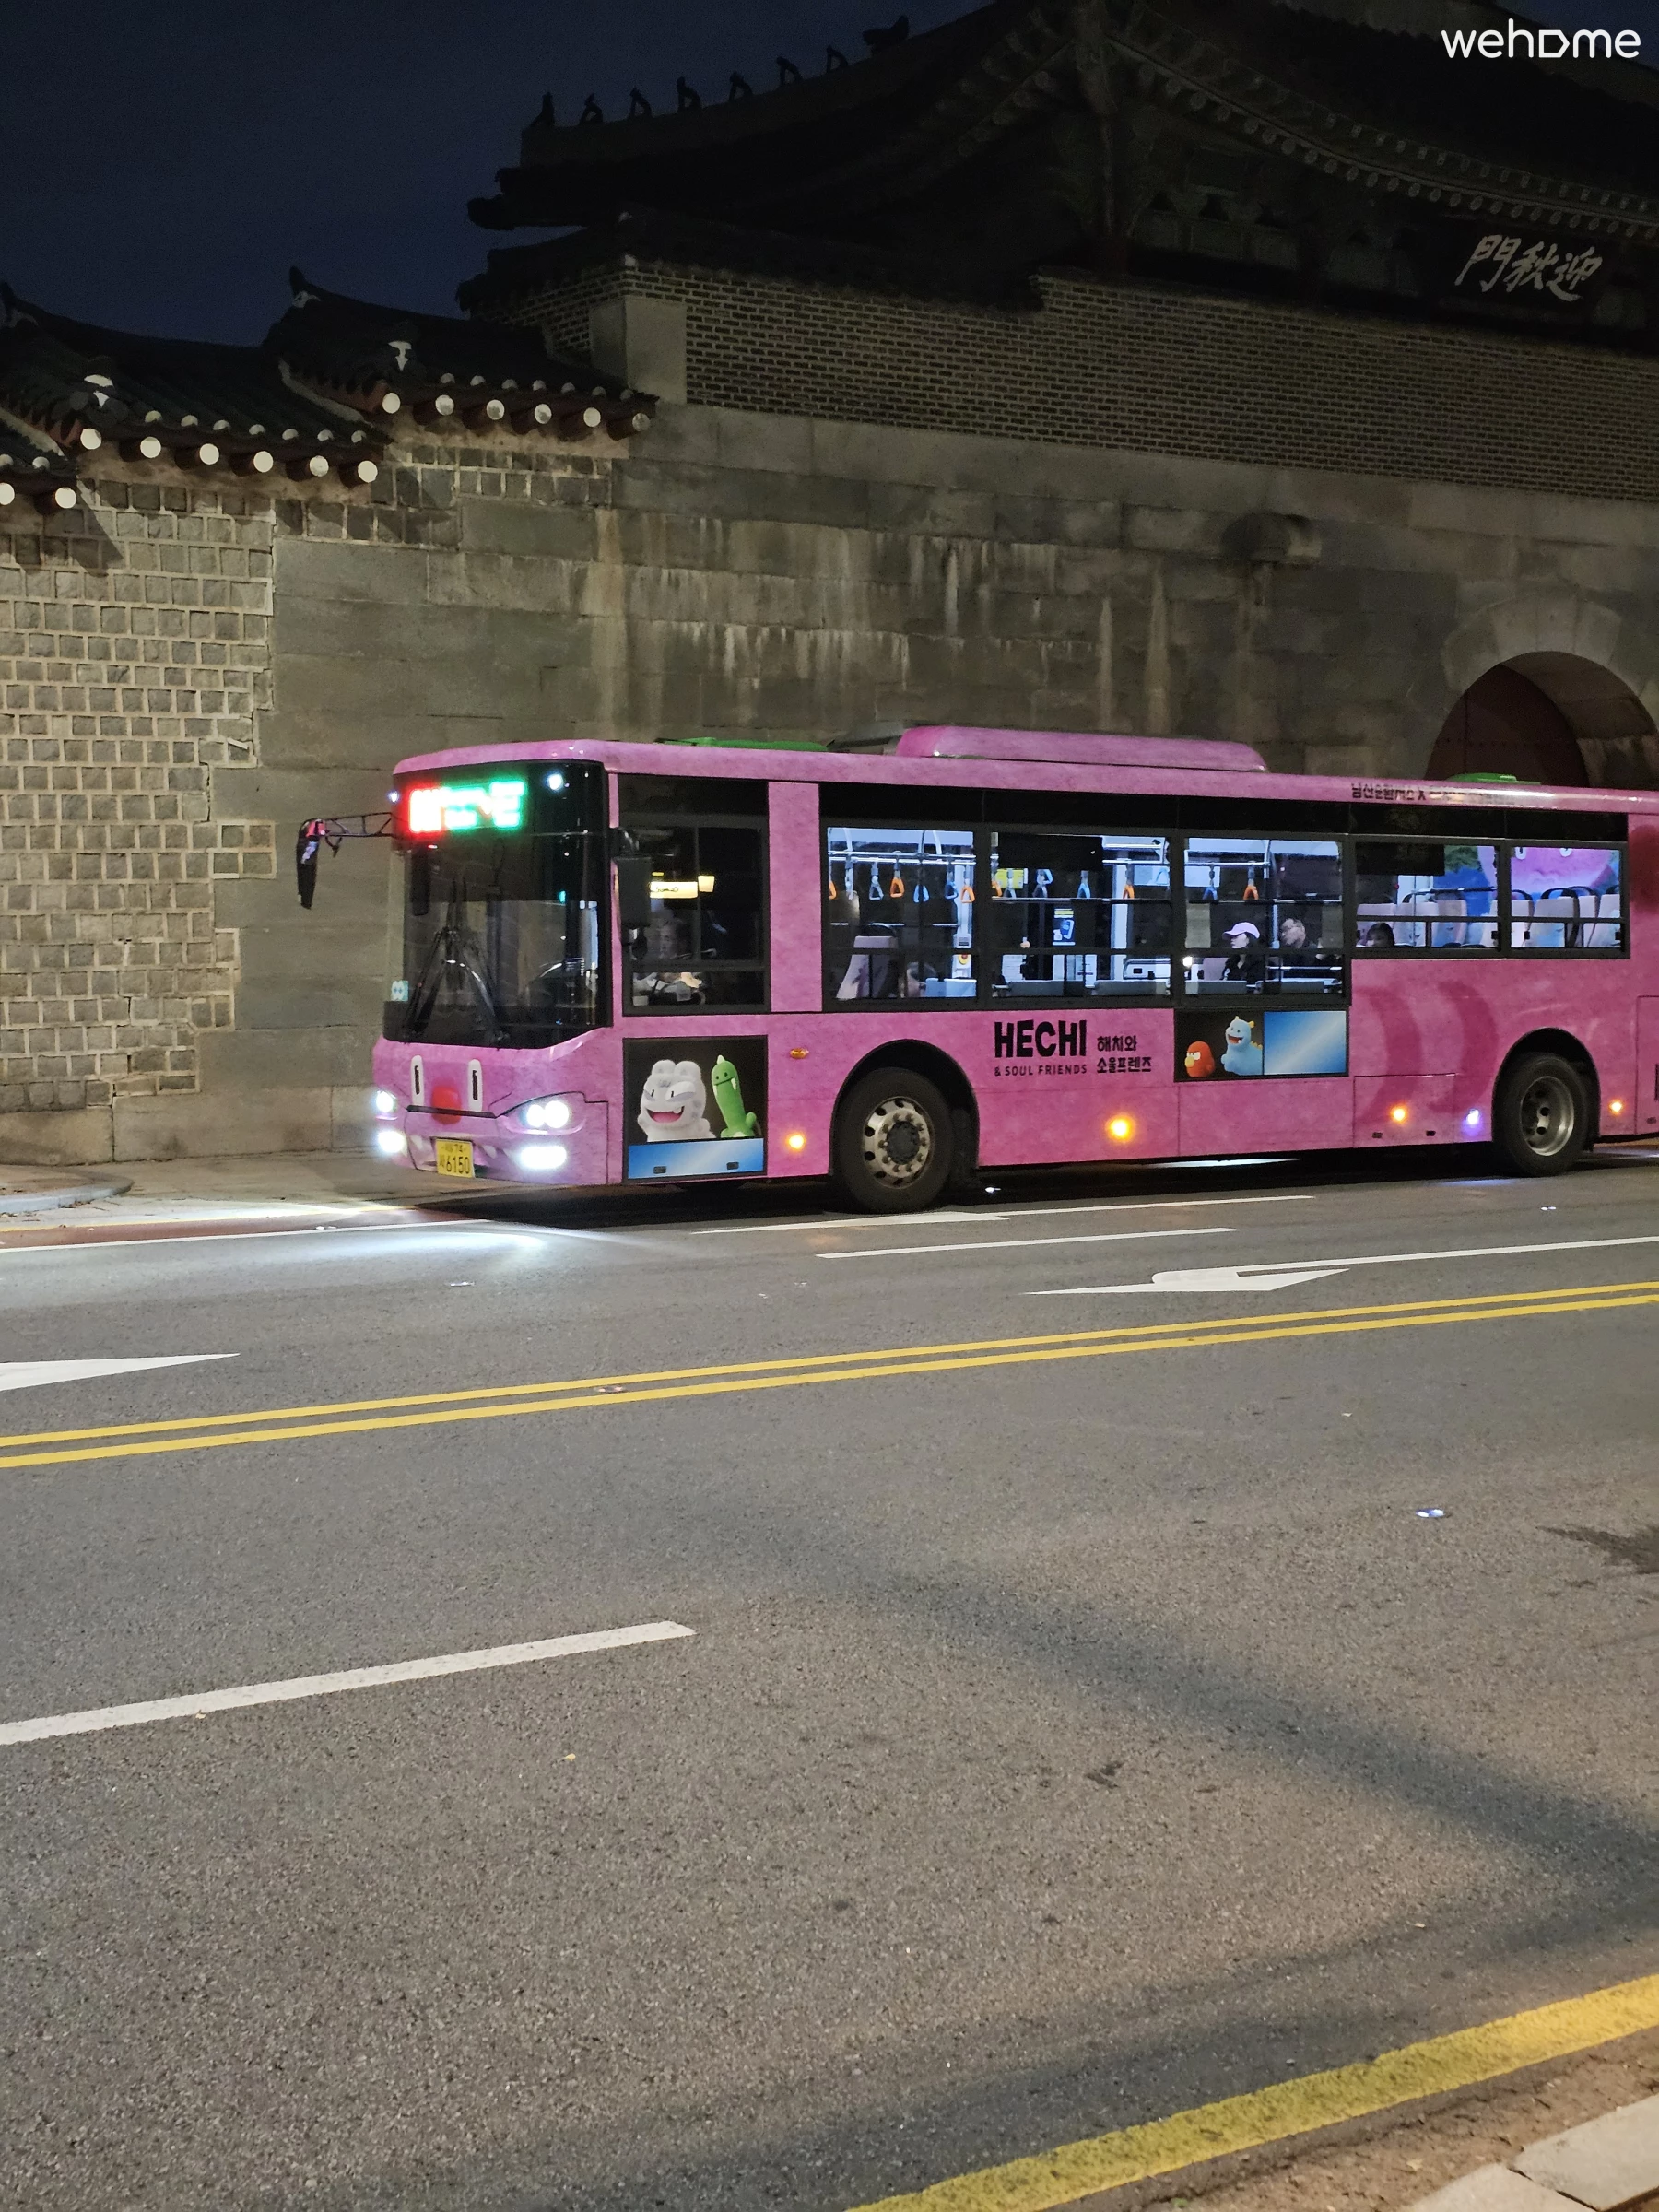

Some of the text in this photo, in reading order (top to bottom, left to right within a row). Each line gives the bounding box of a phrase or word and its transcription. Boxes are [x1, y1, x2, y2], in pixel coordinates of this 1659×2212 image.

[994, 1019, 1087, 1058] HECHI
[1097, 1035, 1137, 1052] 해치와
[994, 1064, 1088, 1077] & SOUL FRIENDS
[1097, 1056, 1152, 1074] 소울프렌즈
